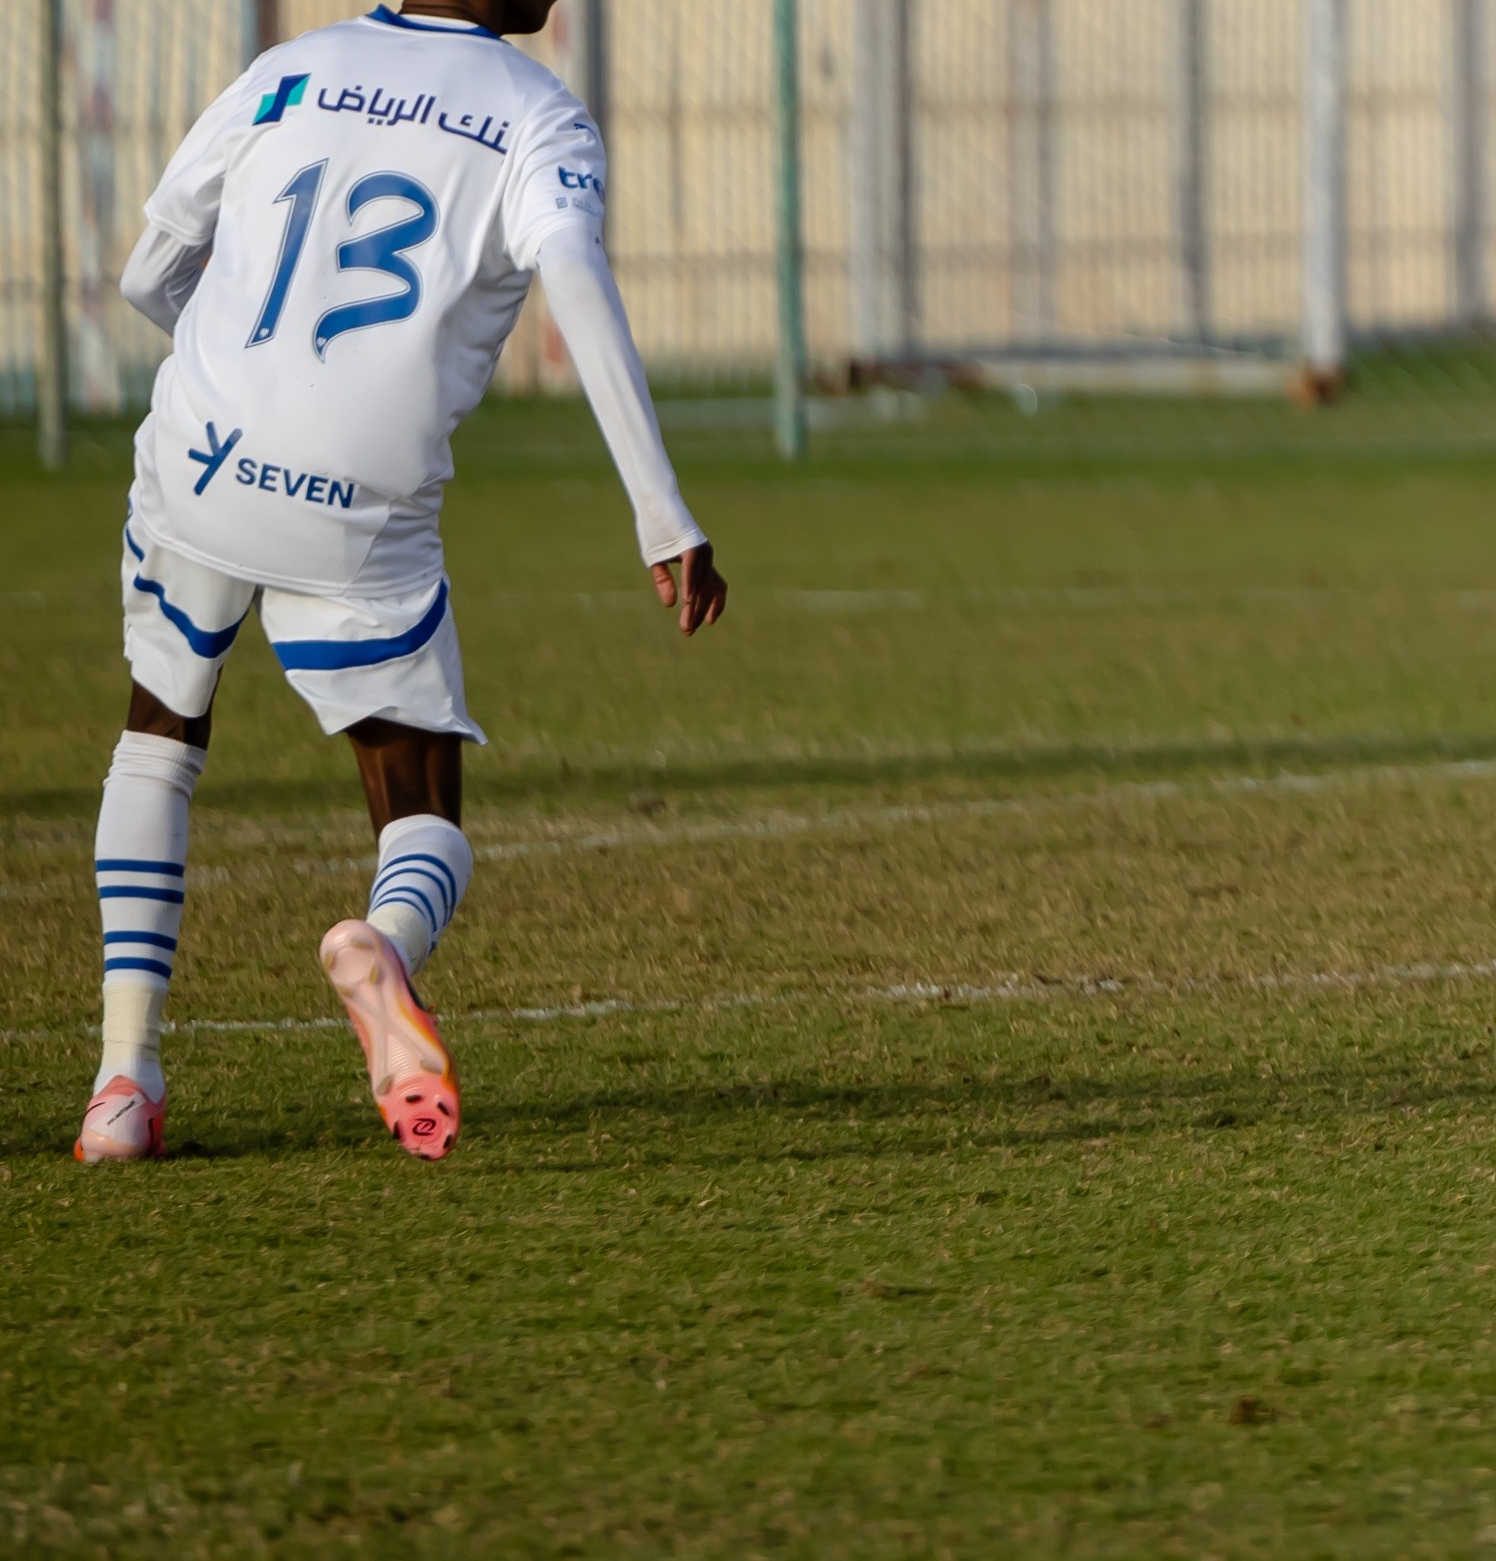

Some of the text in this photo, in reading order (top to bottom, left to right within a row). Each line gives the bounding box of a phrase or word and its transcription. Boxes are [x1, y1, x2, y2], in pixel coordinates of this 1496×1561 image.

[317, 85, 437, 126] الرياض
[244, 158, 439, 364] 13
[235, 457, 356, 509] SEVEN
